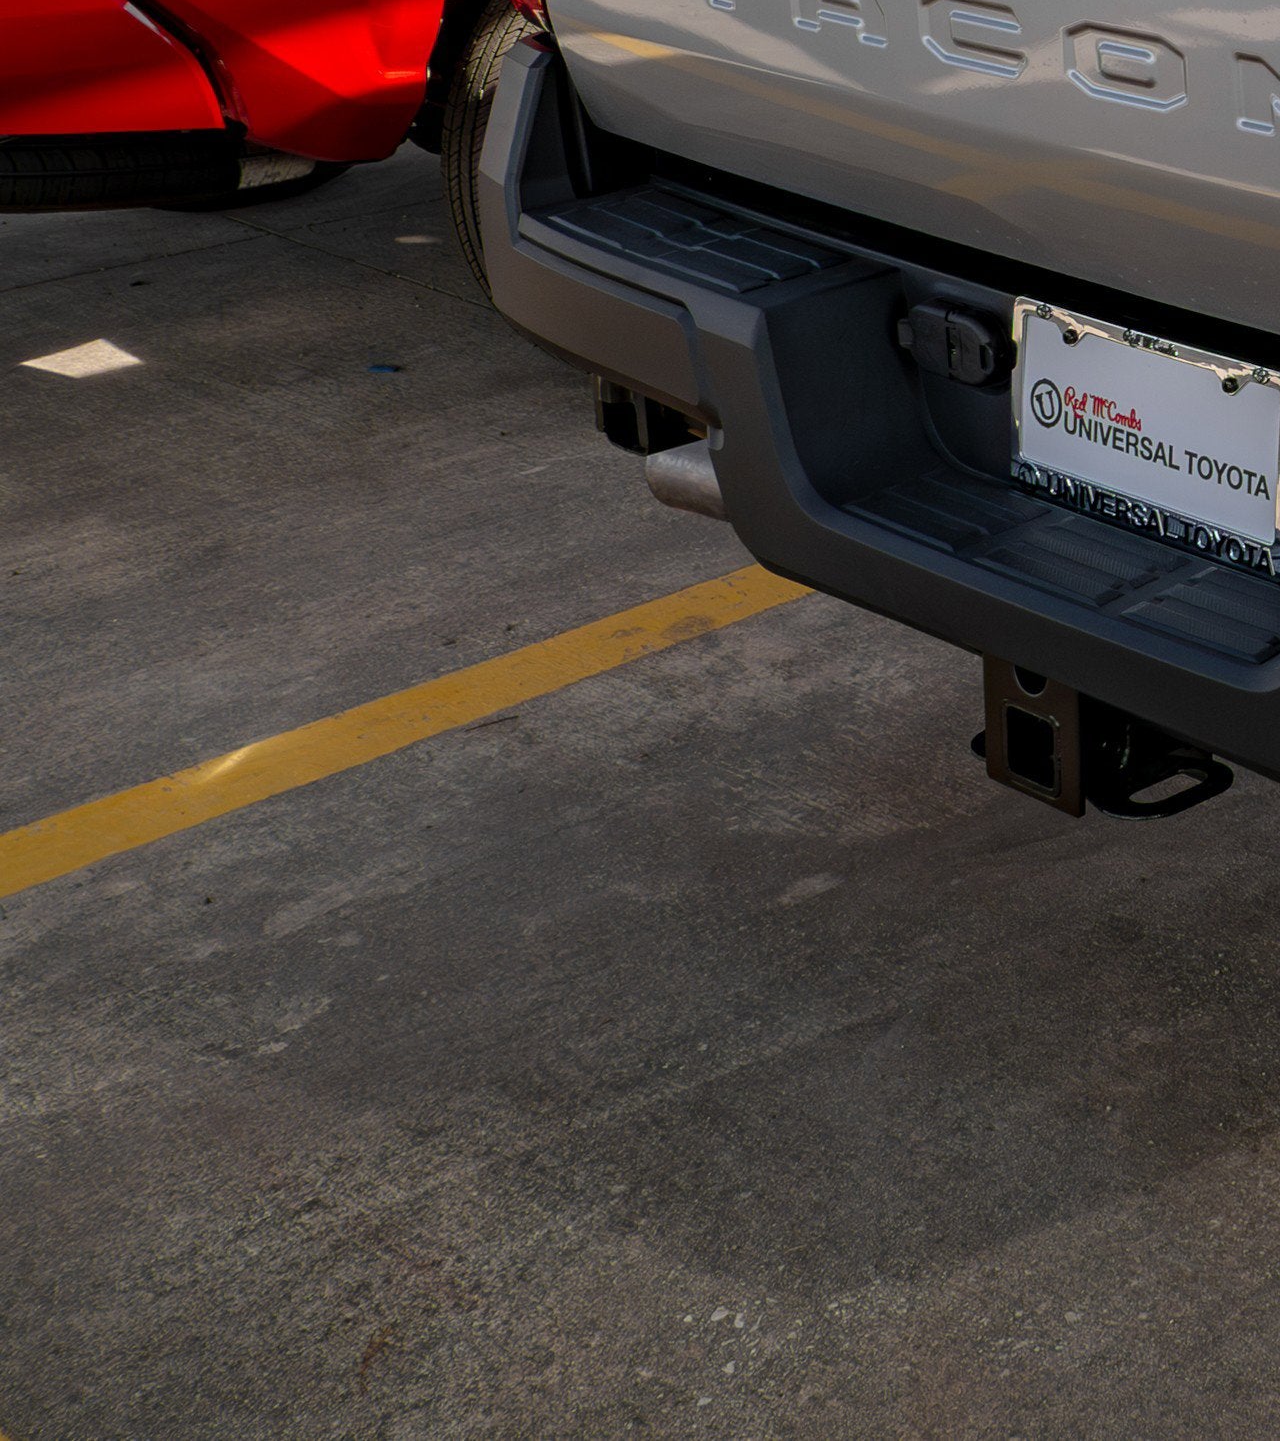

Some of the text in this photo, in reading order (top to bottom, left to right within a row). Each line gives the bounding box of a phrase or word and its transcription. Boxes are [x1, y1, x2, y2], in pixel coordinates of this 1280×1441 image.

[1063, 386, 1142, 432] Red McCombs
[1064, 410, 1270, 501] UNIVERSAL TOYOTA
[1046, 468, 1277, 577] UNIVERSAL TOYOTA
